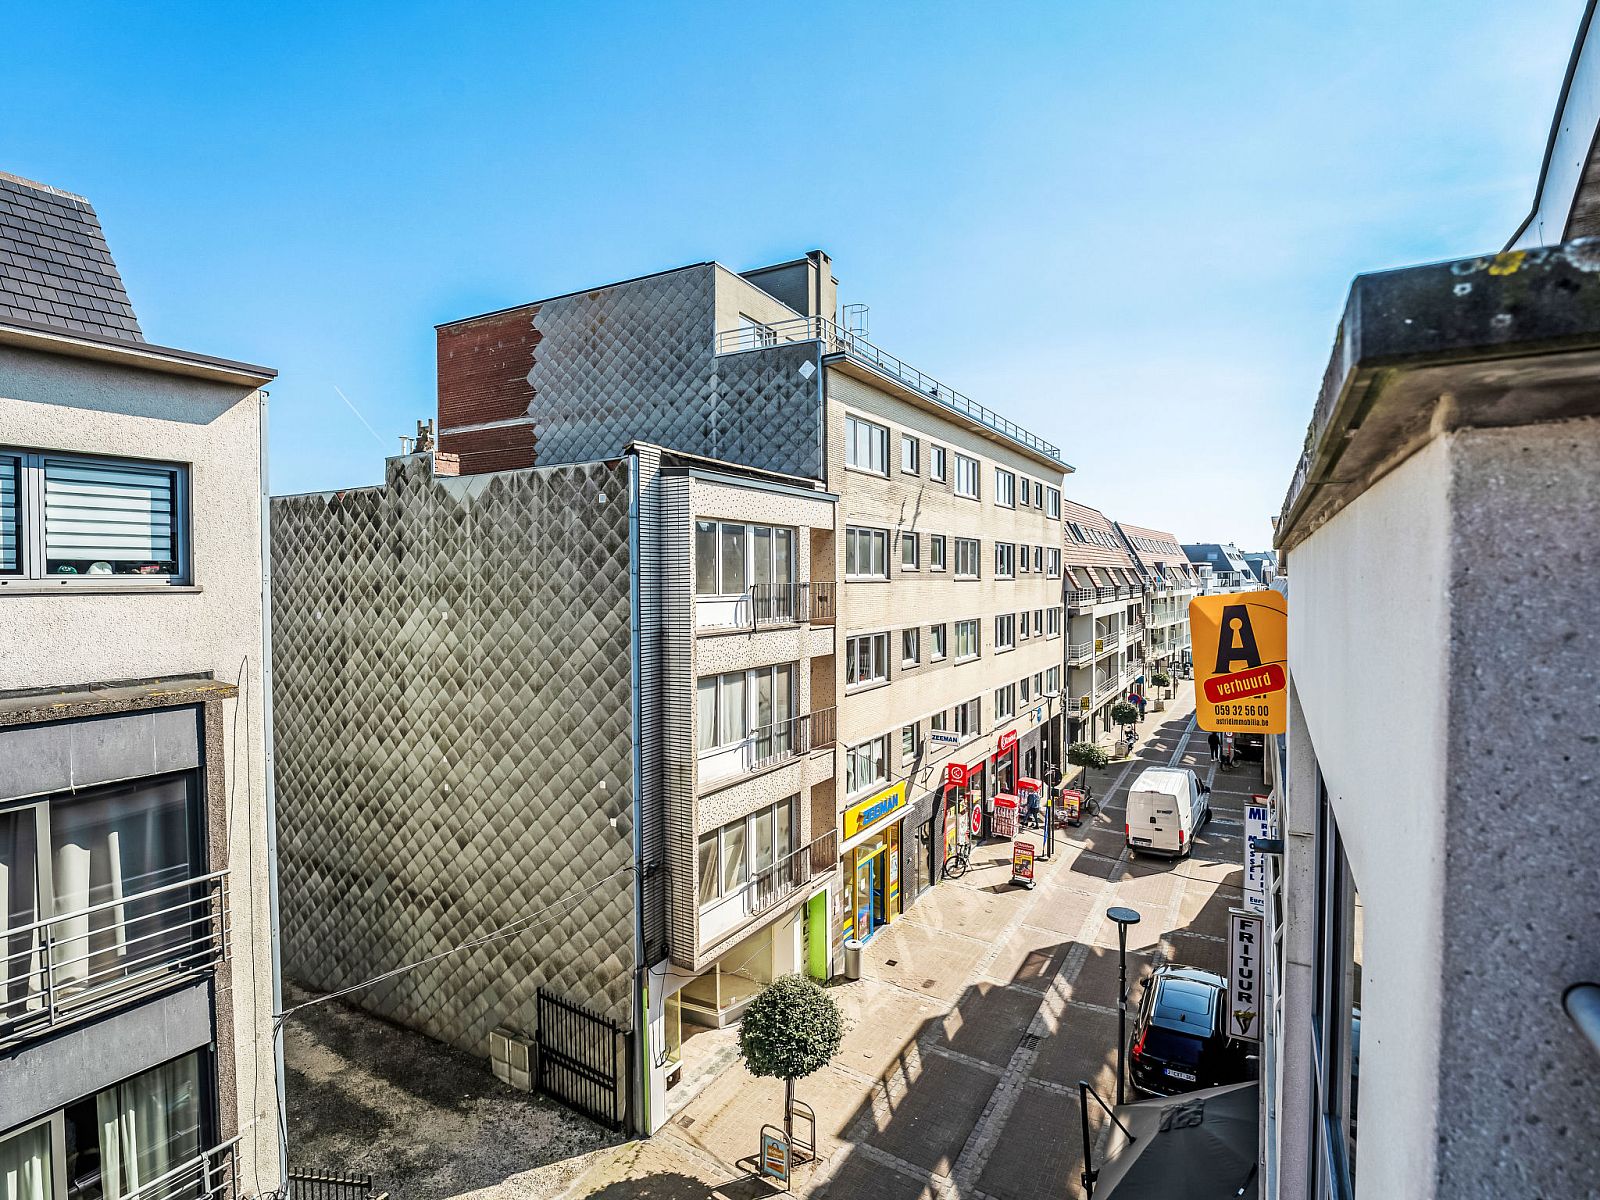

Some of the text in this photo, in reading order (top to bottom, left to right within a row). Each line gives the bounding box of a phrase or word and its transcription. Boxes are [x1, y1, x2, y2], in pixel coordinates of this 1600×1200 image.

[1216, 672, 1272, 696] verhuurd
[1214, 704, 1269, 717] 059 32 56 00
[1215, 718, 1269, 727] astridimmobilia.be
[931, 734, 958, 743] ZEEMAN
[862, 793, 899, 826] ZEEMAN
[1238, 919, 1254, 1004] FRITUUR
